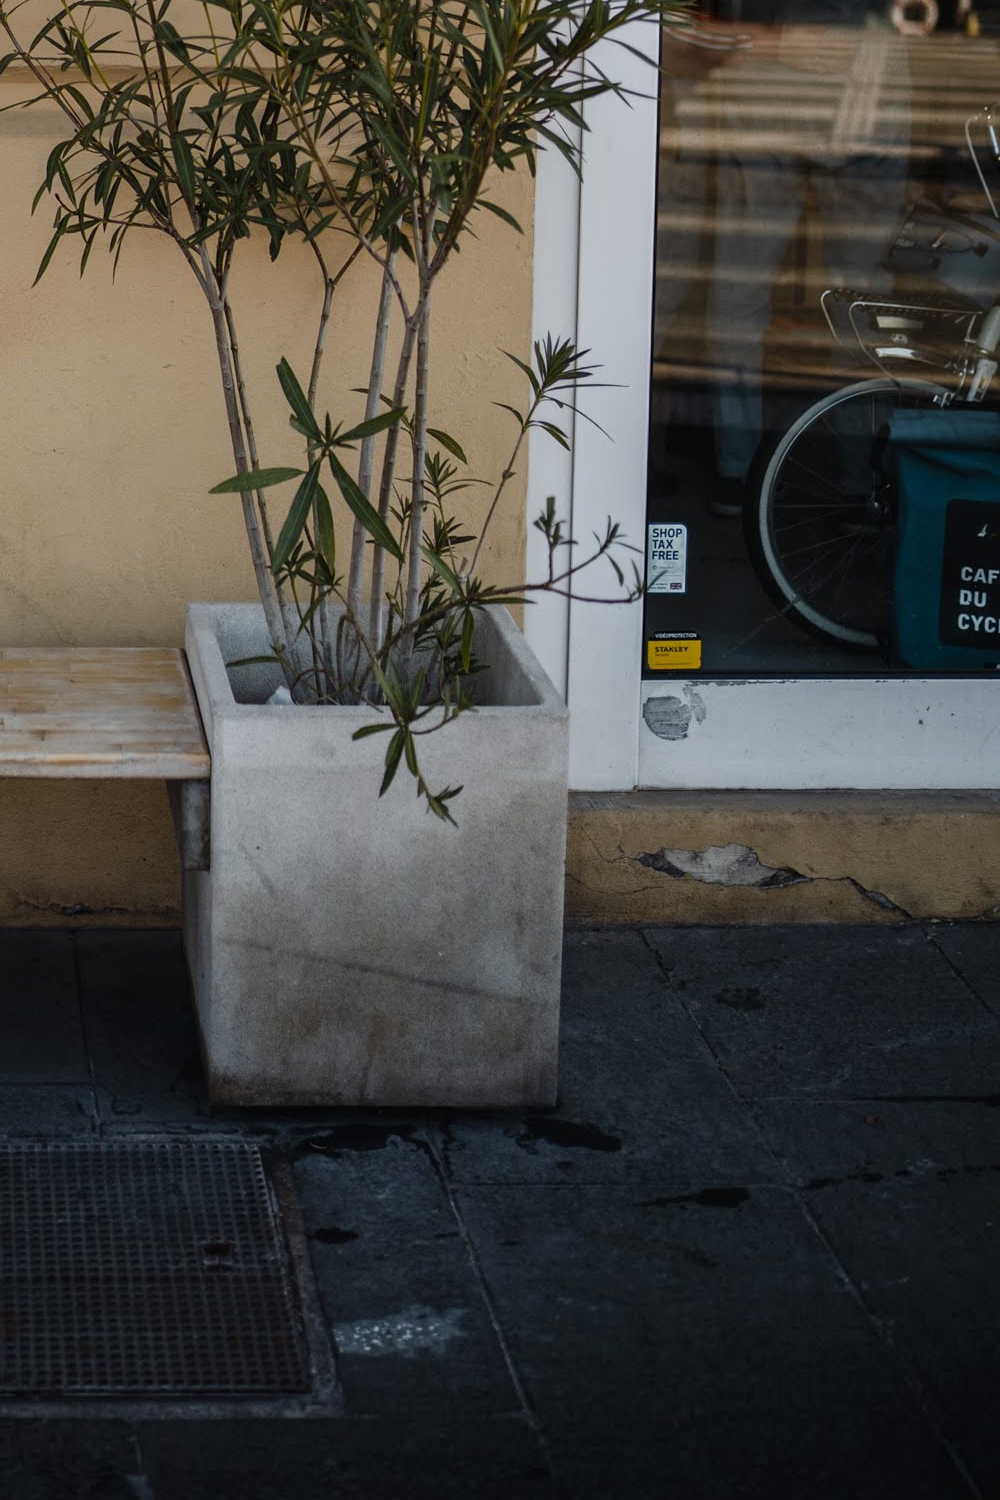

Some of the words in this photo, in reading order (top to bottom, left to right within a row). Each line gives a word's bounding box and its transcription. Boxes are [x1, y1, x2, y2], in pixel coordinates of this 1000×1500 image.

[652, 528, 683, 538] SHOP
[652, 539, 673, 549] TAX
[651, 550, 680, 560] FREE
[959, 589, 987, 607] DU
[958, 613, 1000, 633] CYC
